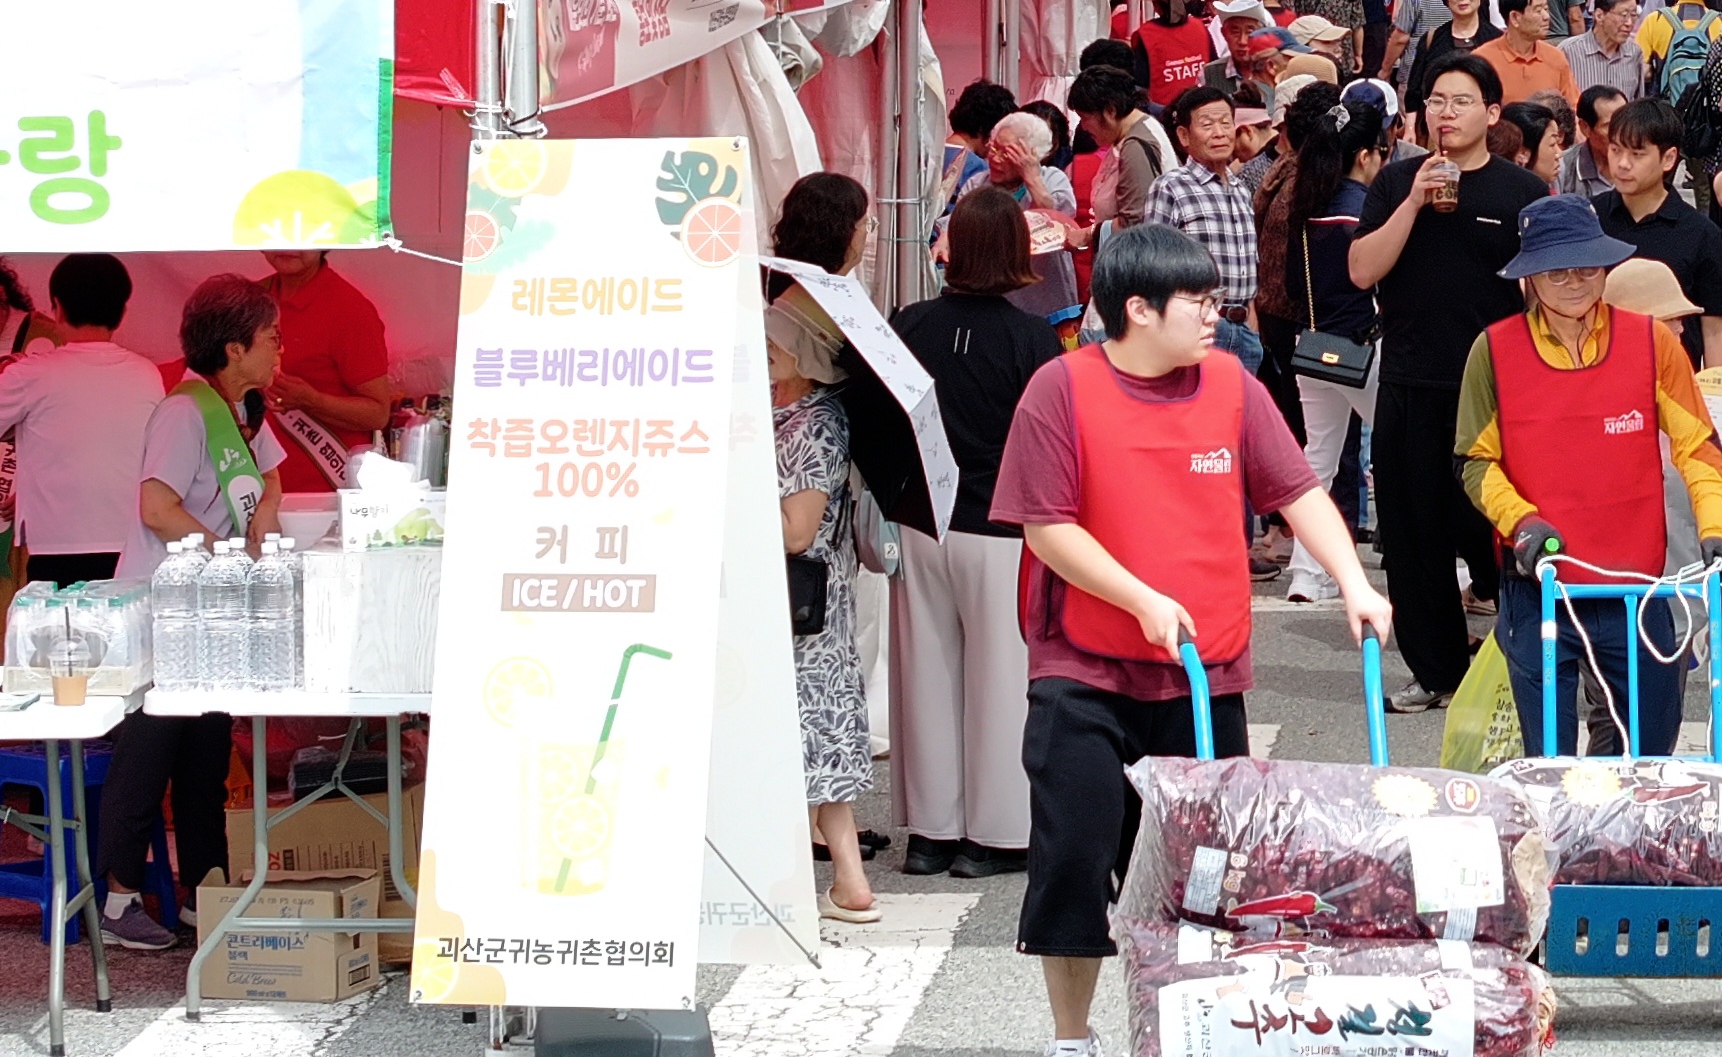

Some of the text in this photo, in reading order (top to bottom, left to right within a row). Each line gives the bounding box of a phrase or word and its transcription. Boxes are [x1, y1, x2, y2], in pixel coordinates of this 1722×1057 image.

[511, 276, 683, 316] 레몬에이드
[473, 347, 714, 387] 블루베리에이드
[467, 417, 711, 458] 착즙오렌지쥬스
[533, 462, 640, 498] 100%
[437, 937, 675, 968] 괴산군귀농귀촌협의회
